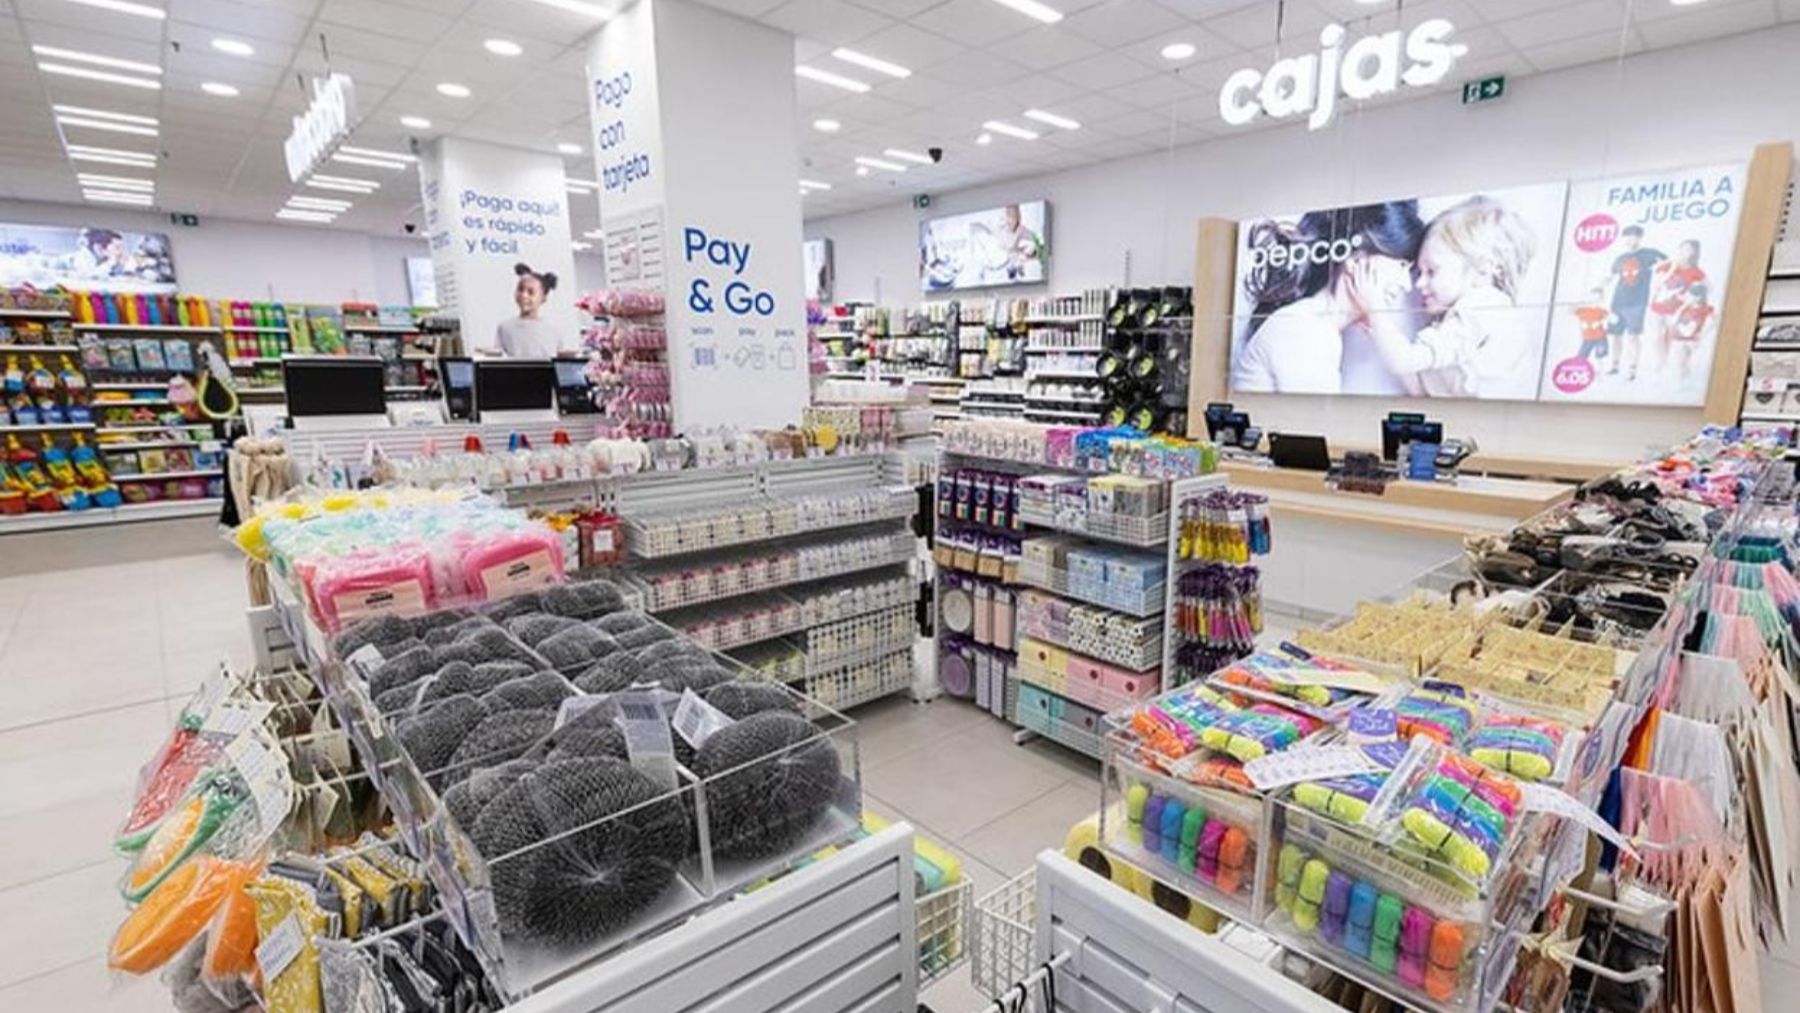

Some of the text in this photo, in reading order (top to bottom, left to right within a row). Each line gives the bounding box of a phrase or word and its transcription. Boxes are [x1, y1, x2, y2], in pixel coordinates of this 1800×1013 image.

[595, 71, 632, 109] Pago
[1219, 18, 1461, 131] cajas
[599, 120, 626, 150] con
[603, 153, 650, 193] tarjeta
[1608, 175, 1733, 206] FAMILIA A
[463, 216, 485, 230] es
[1638, 198, 1730, 223] JUEGO
[465, 238, 476, 253] y
[685, 227, 750, 275] Pay
[689, 278, 775, 316] & Go
